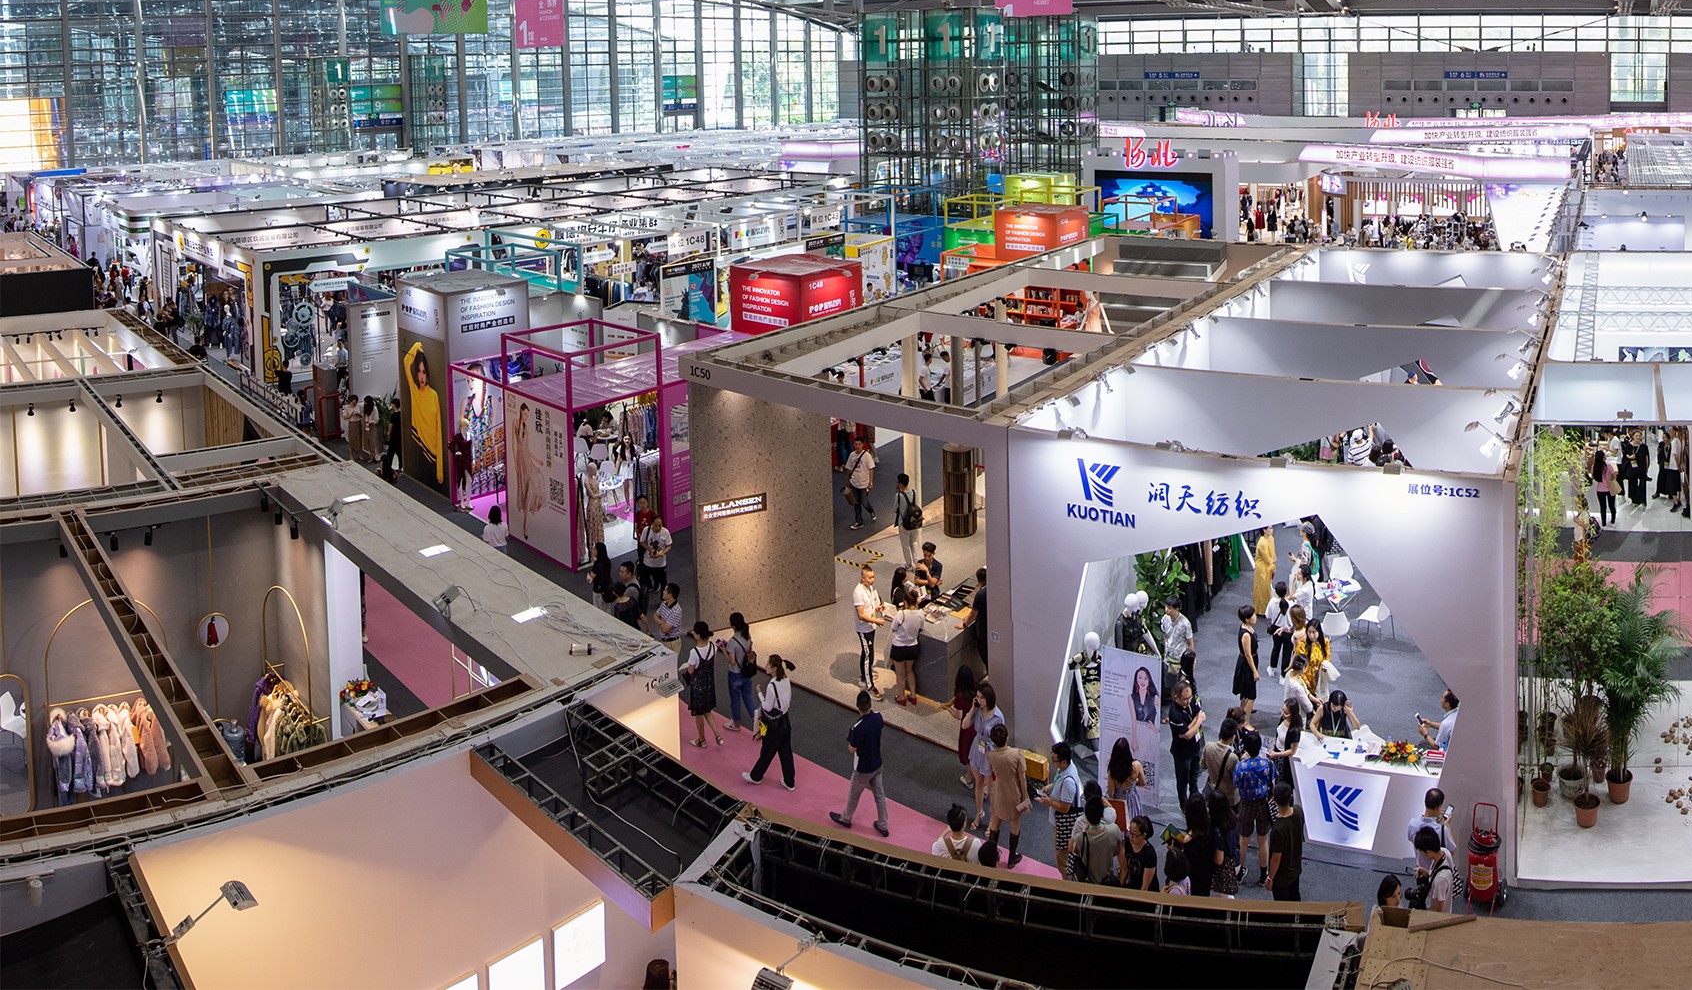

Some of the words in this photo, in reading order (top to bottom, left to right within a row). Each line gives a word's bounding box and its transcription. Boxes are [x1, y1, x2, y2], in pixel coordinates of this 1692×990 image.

[873, 25, 886, 55] 1
[937, 23, 951, 53] 1
[985, 21, 996, 52] 1
[334, 63, 342, 79] 1
[1124, 136, 1179, 168] 河北
[824, 211, 840, 222] 1C48
[1014, 223, 1039, 231] INNOVATOR
[684, 234, 706, 247] 1C48
[742, 284, 752, 293] THE
[752, 286, 781, 297] INNOVATOR
[808, 280, 824, 290] 1C48
[472, 293, 506, 303] INNOVATOR
[749, 295, 771, 305] FASHION
[771, 297, 790, 307] DESIGN
[460, 305, 469, 313] OF
[469, 302, 495, 312] FASHION
[494, 299, 516, 309] DESIGN
[742, 303, 772, 313] INSPIRATION
[460, 310, 497, 321] INSPIRATION
[690, 365, 711, 380] 1C50
[1407, 483, 1481, 499] 展位号:1C52
[721, 496, 763, 509] LANSEN
[1066, 502, 1136, 529] KUOTIAN
